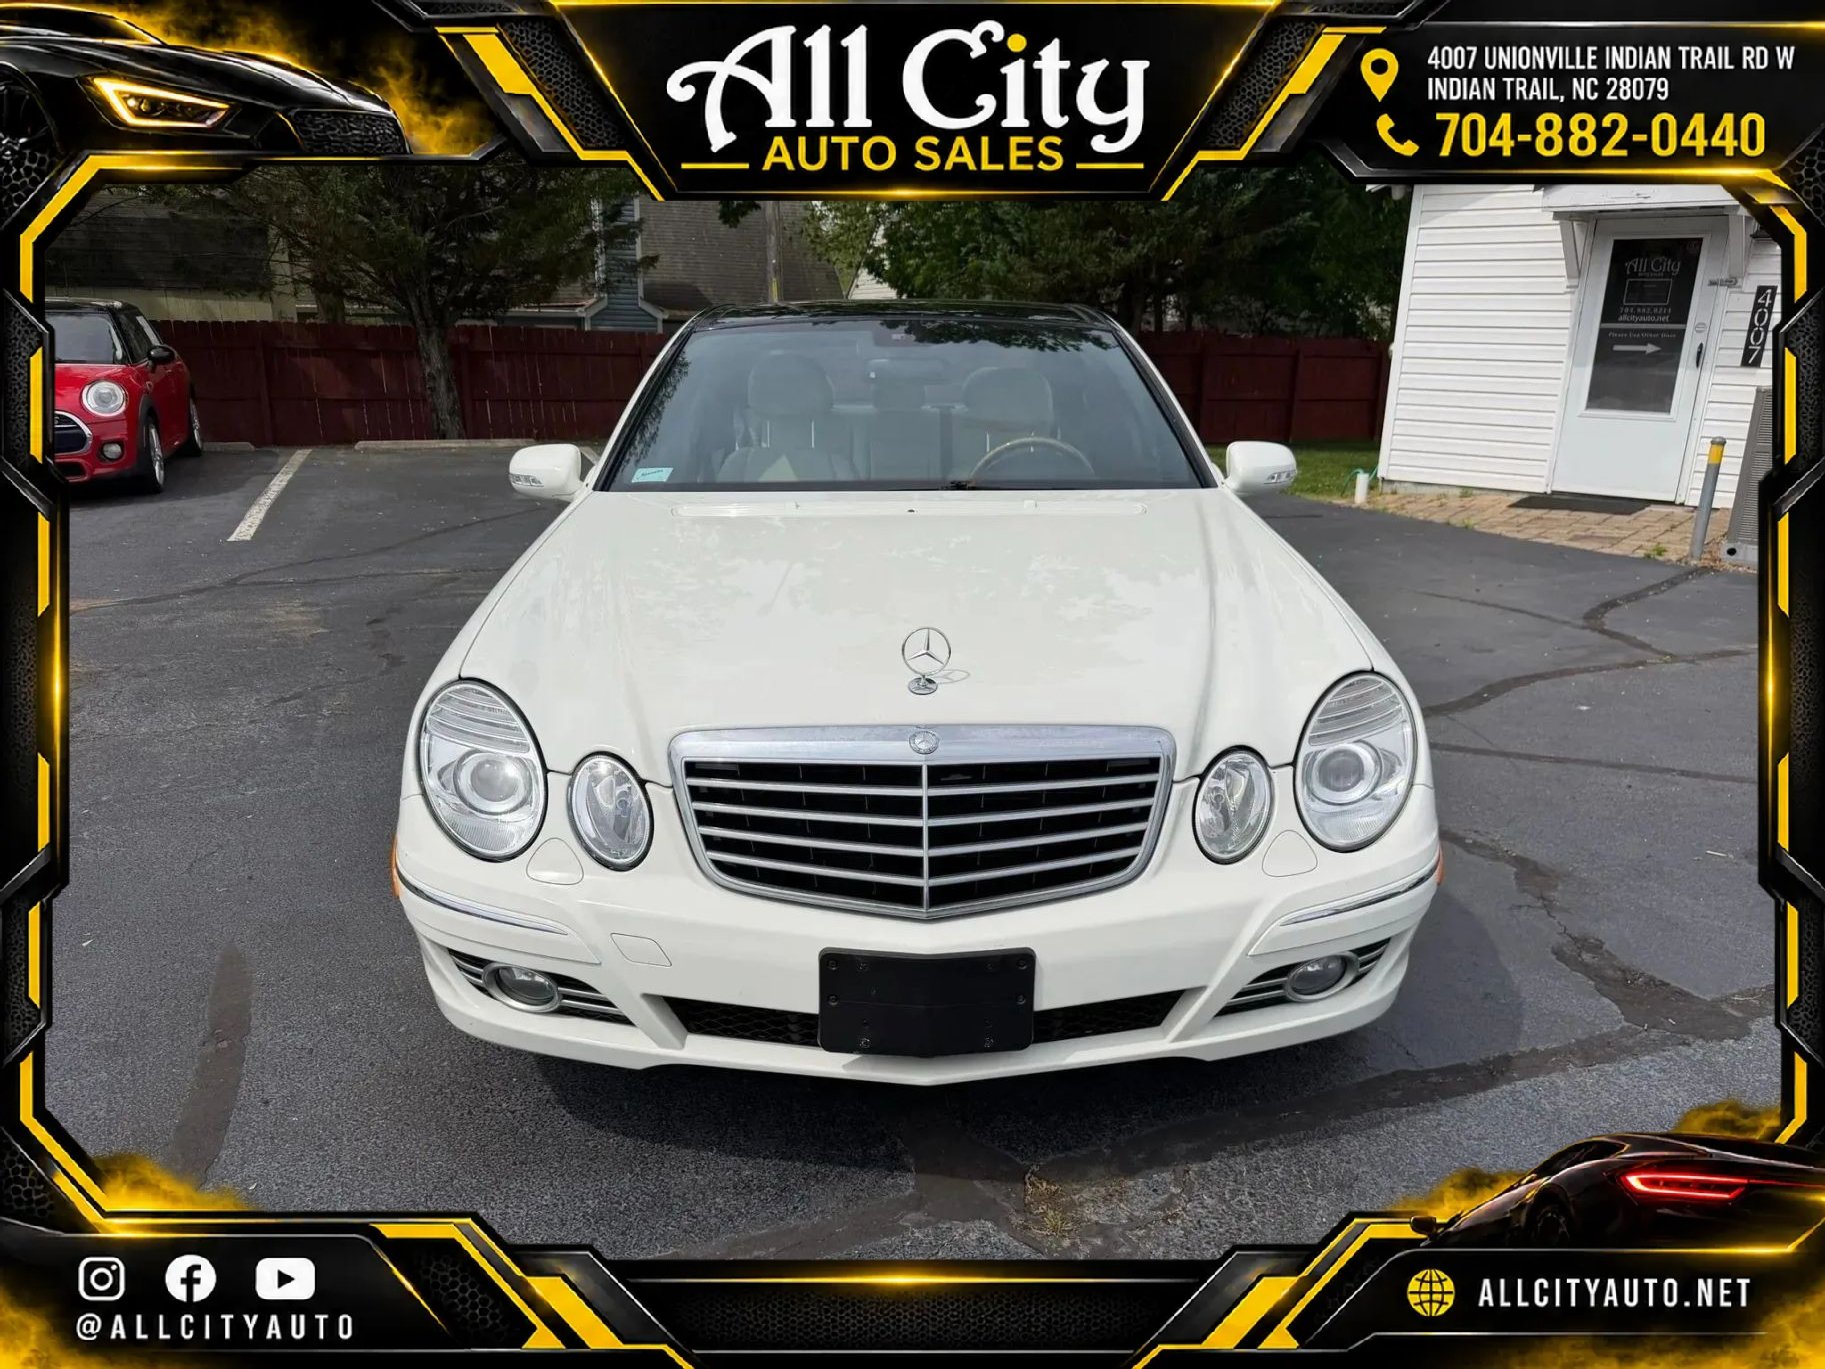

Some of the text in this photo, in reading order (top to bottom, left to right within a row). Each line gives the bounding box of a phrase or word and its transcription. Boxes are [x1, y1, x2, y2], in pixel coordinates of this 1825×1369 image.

[1624, 256, 1681, 276] All City
[1748, 289, 1772, 364] 4007
